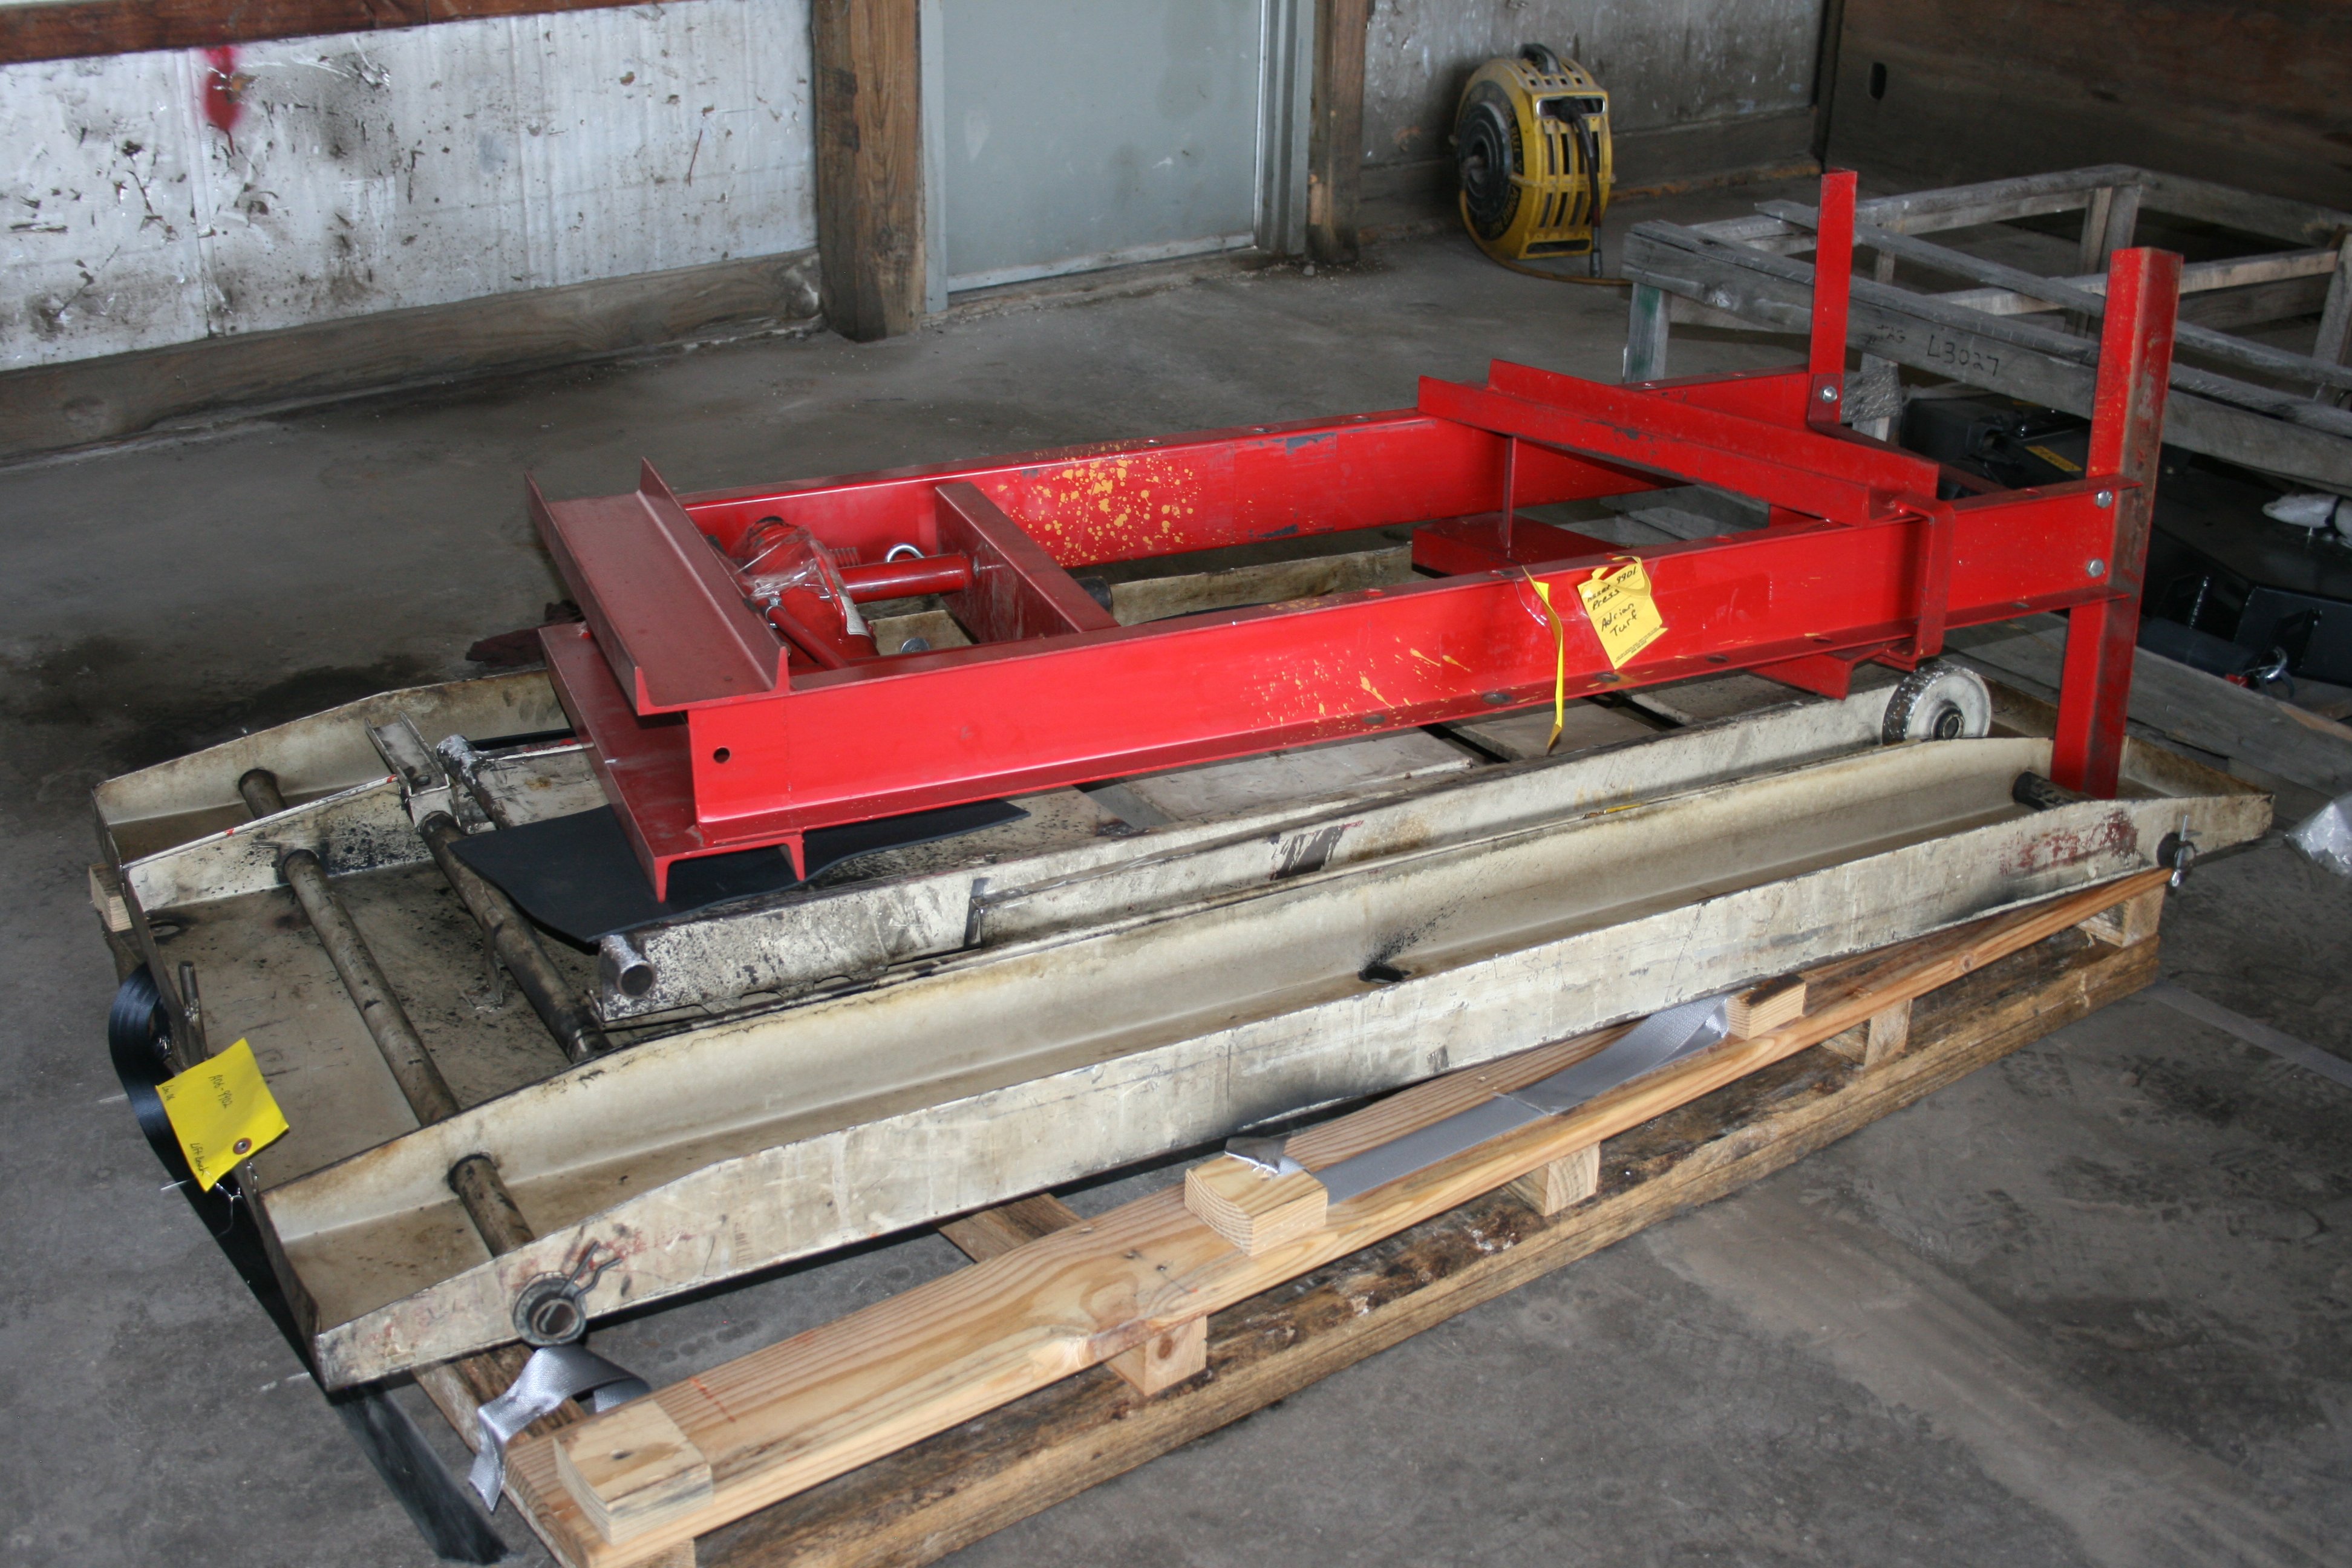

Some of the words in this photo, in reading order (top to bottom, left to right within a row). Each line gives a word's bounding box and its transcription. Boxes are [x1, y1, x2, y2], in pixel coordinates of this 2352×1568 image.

[1927, 334, 1999, 377] L3027
[1592, 589, 1620, 611] Press
[1601, 603, 1635, 632] Adrian
[1609, 609, 1637, 637] Turf
